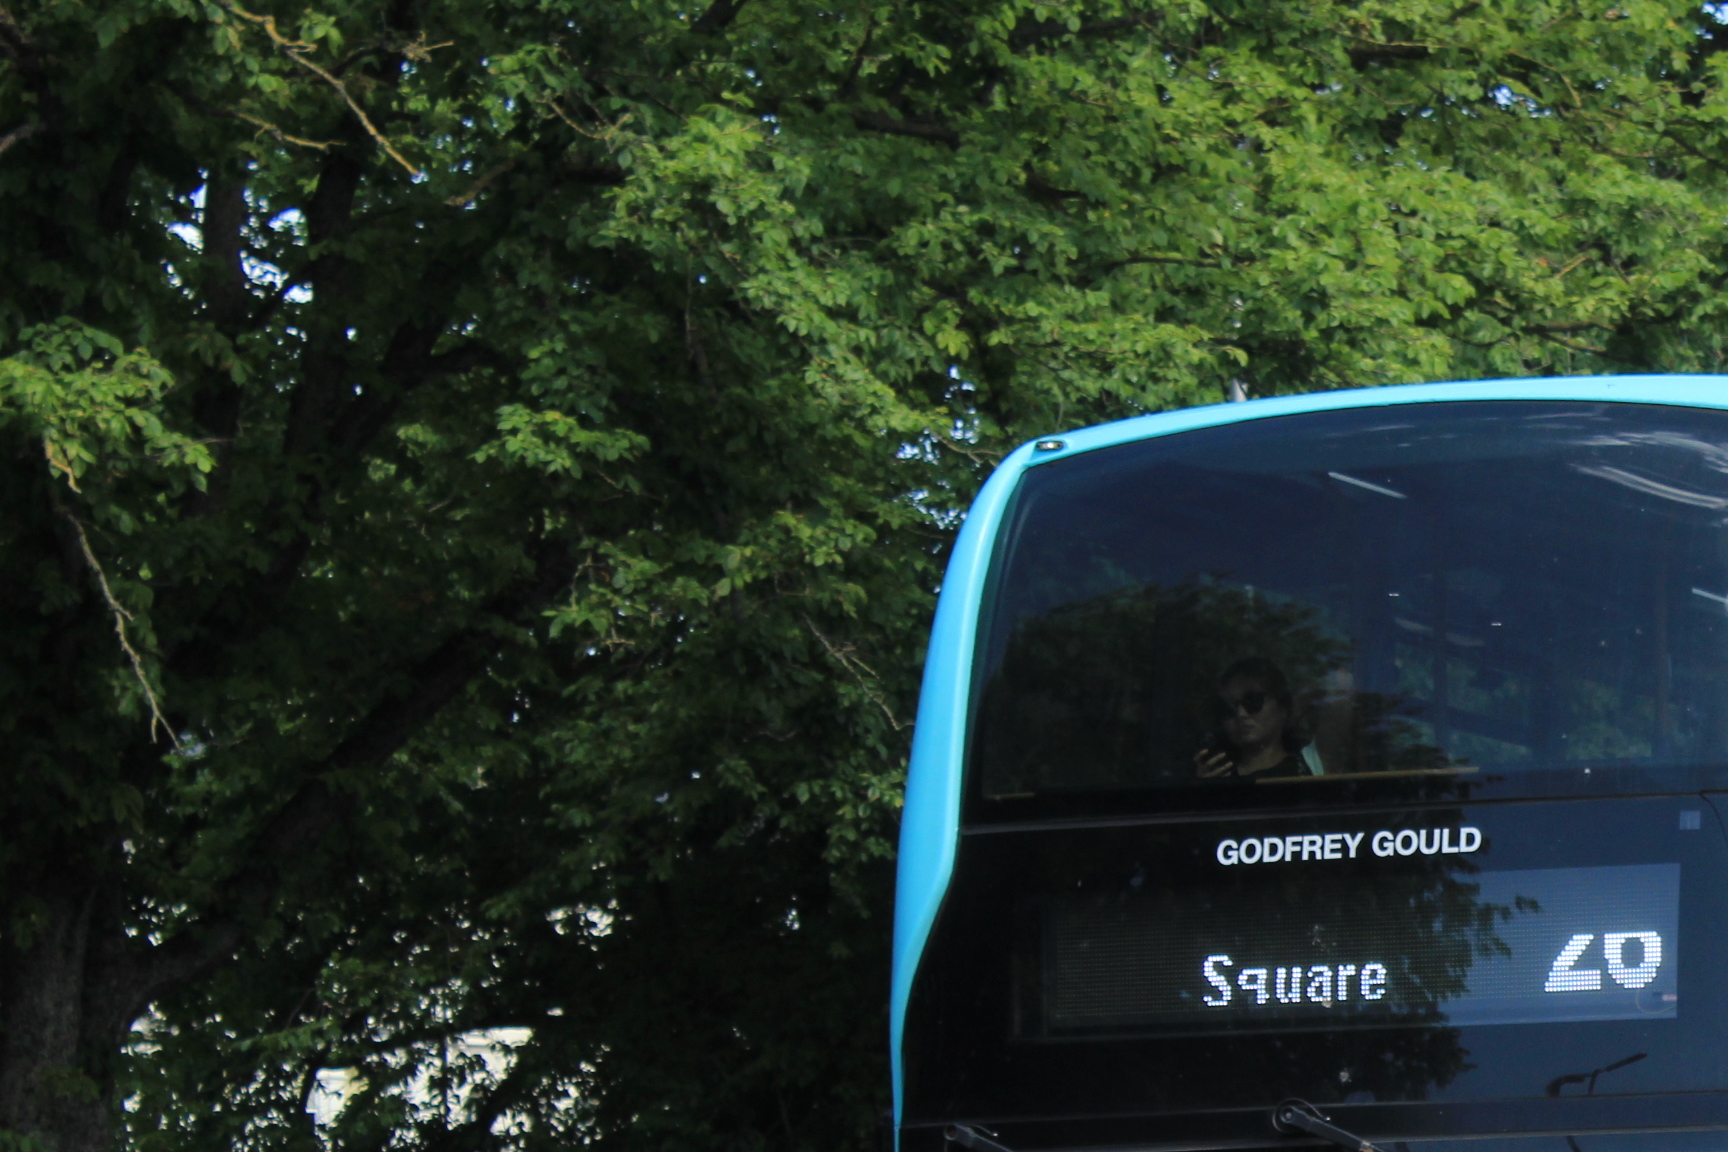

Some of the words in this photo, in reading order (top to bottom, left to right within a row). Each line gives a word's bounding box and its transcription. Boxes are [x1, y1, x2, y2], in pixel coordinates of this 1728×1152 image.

[1216, 832, 1364, 866] GODFREY
[1371, 826, 1482, 857] GOULD
[1202, 953, 1387, 1007] Square
